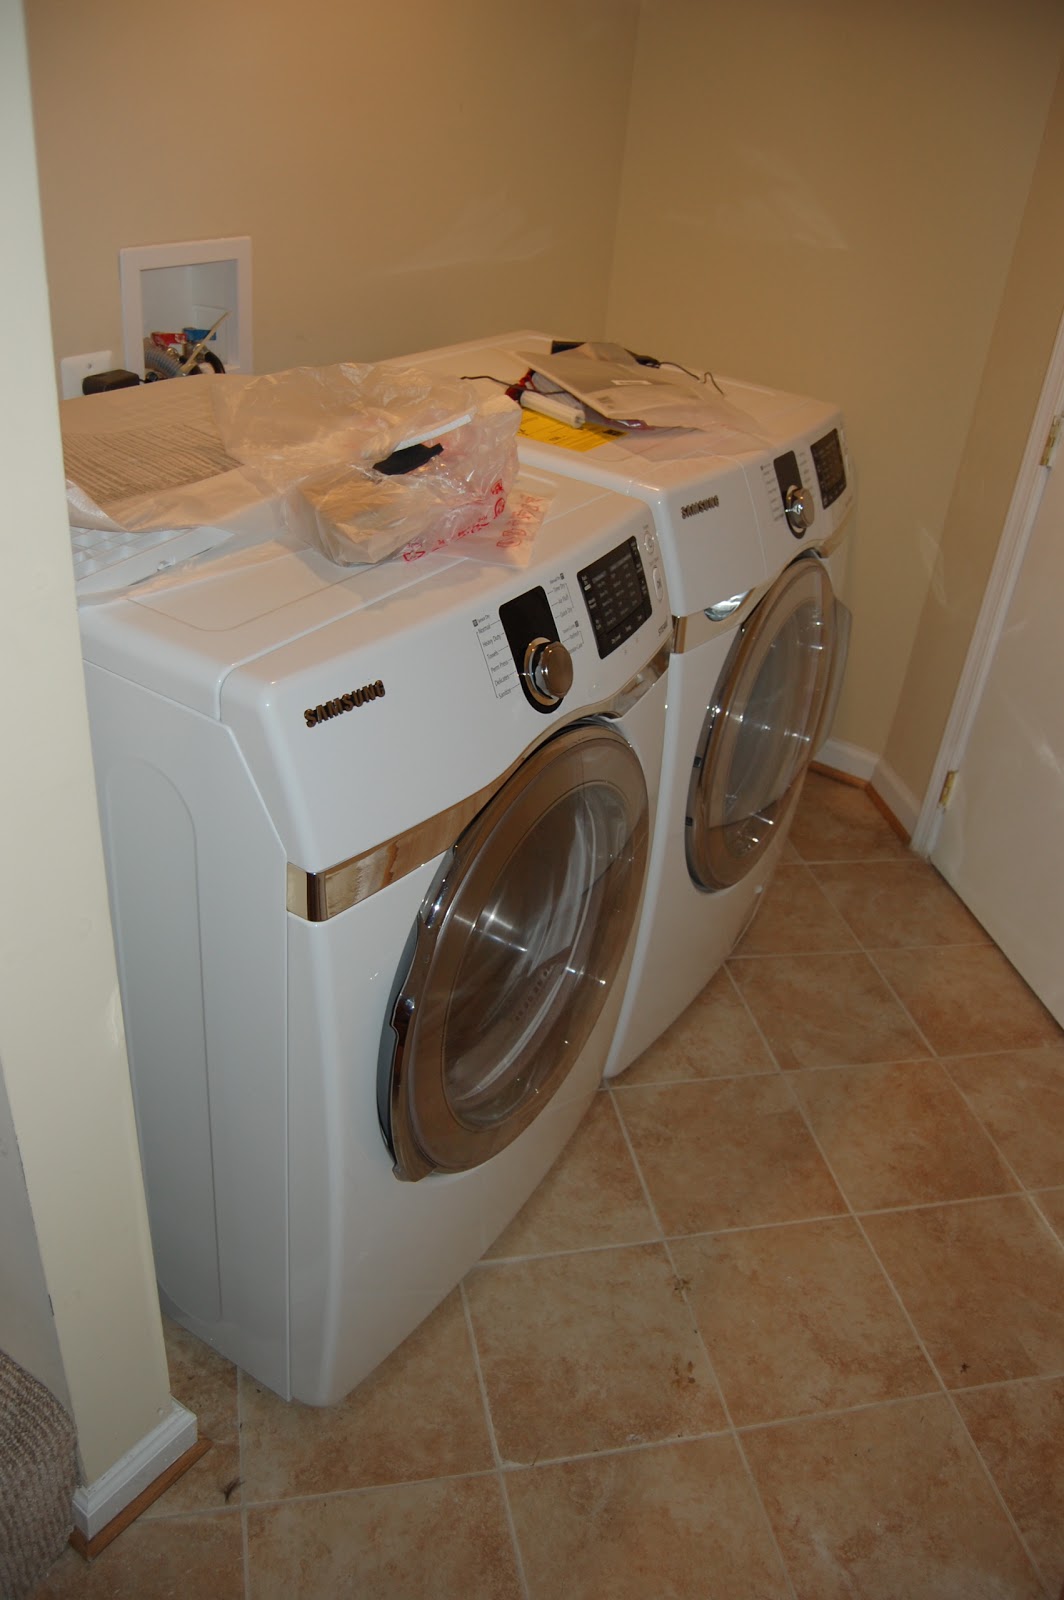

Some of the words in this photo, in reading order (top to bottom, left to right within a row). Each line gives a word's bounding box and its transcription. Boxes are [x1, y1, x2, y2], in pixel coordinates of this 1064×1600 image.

[681, 495, 719, 519] SAMSUNG
[478, 624, 491, 634] Normal
[482, 639, 494, 648] Heavy
[493, 634, 501, 642] Duty
[494, 675, 510, 686] Delicates
[303, 680, 385, 728] SAMSUNG
